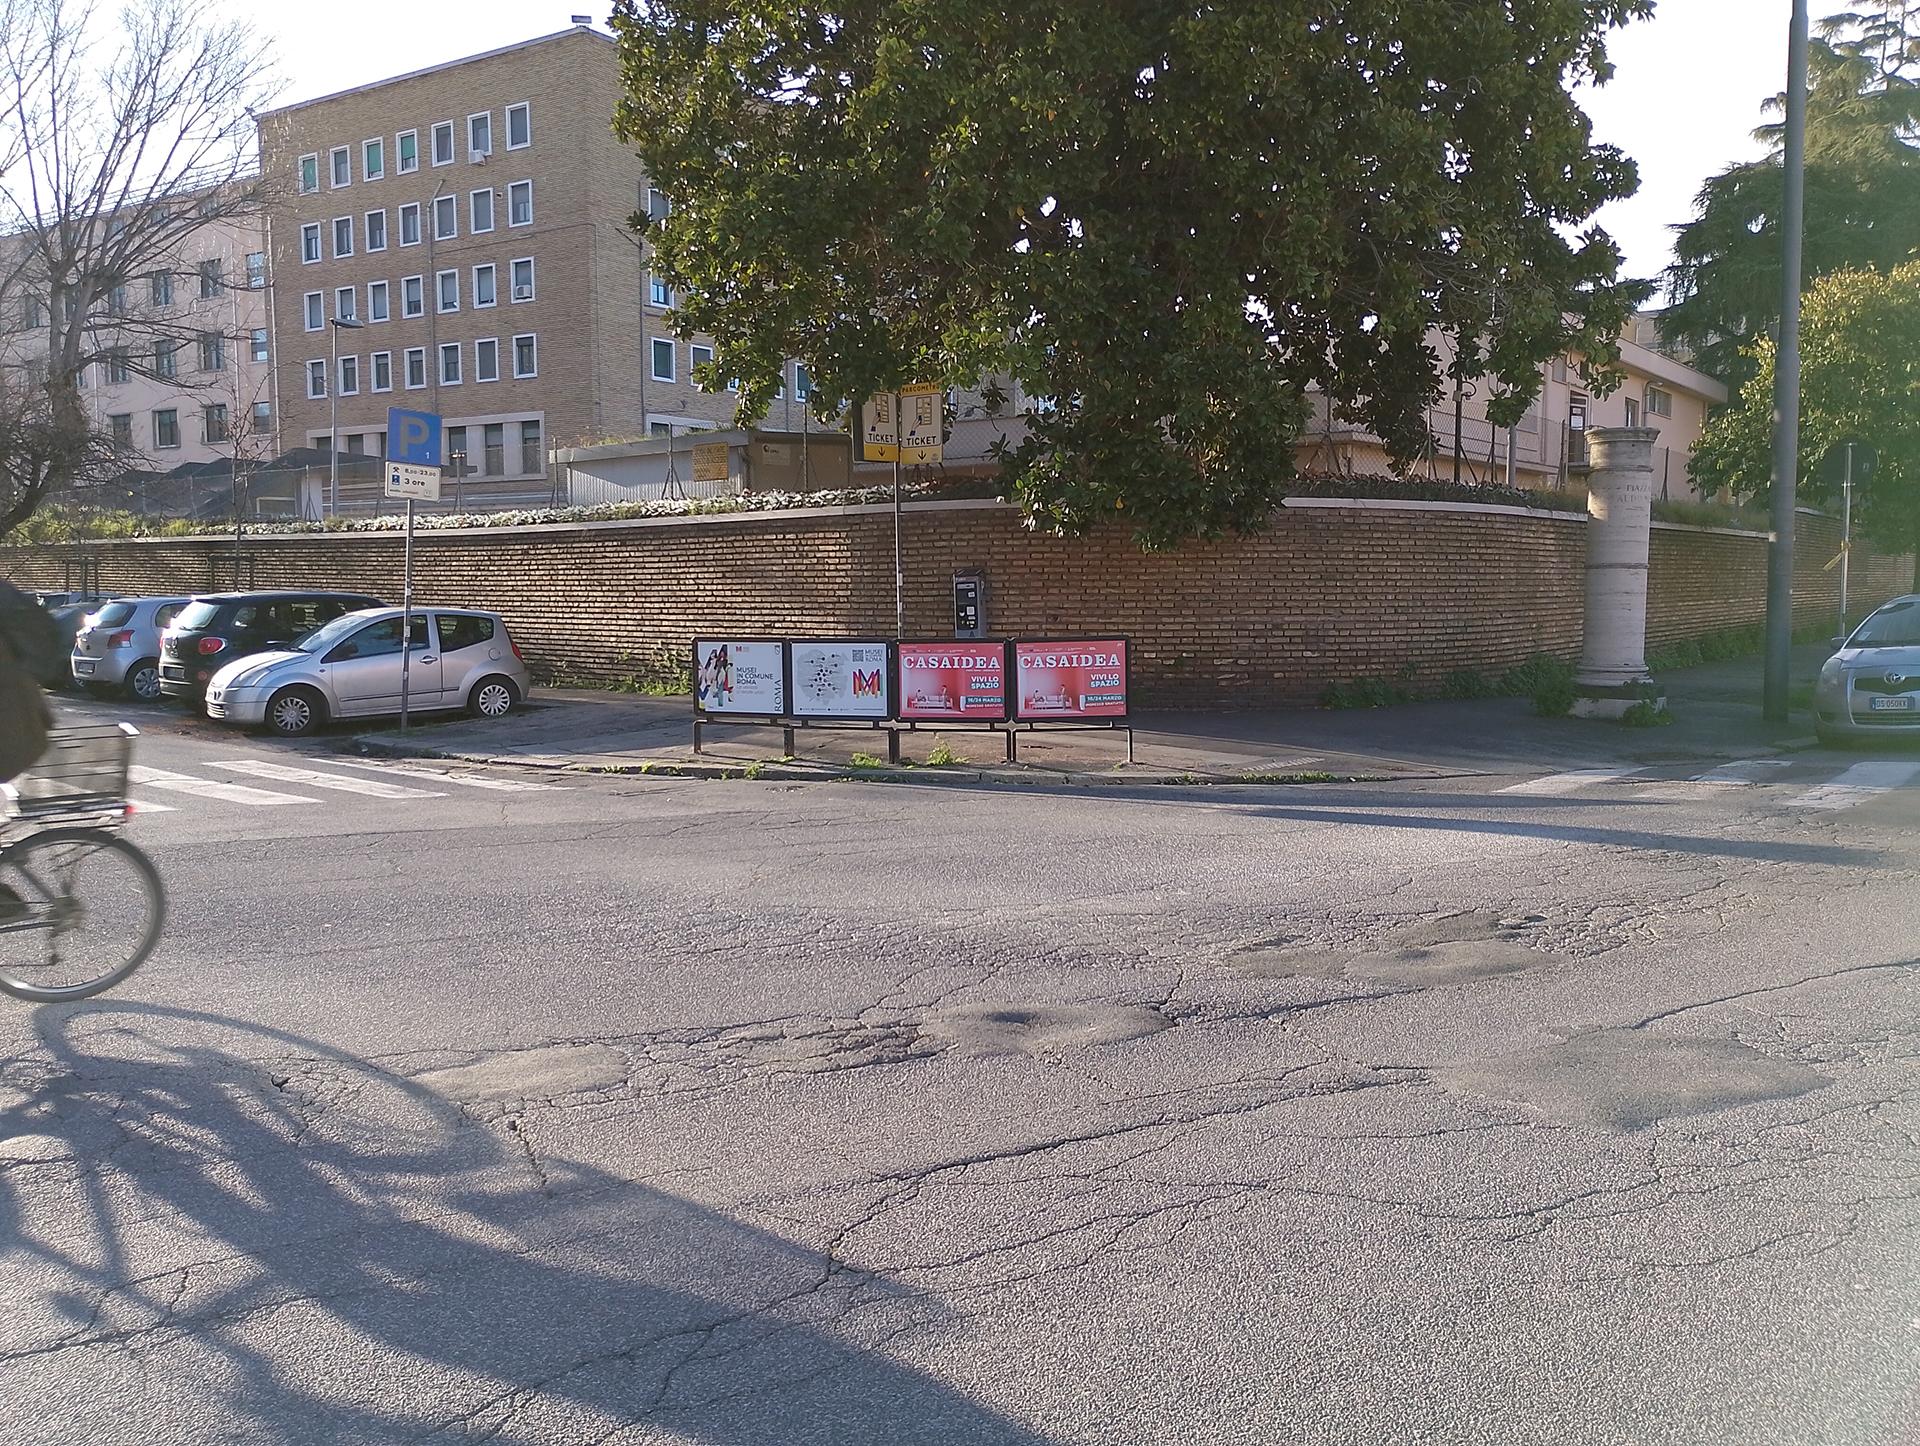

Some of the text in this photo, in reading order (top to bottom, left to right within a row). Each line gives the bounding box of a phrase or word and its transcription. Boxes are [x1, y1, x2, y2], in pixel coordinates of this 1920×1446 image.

[400, 415, 430, 457] P
[868, 433, 893, 443] TICKET
[906, 436, 937, 446] TICKET
[404, 477, 410, 485] 3
[903, 656, 1000, 669] CASAIDEA
[1020, 653, 1120, 669] CASAIDEA
[971, 682, 999, 690] SPAZIO
[1090, 680, 1120, 688] SPAZIO
[774, 680, 782, 712] ROMA
